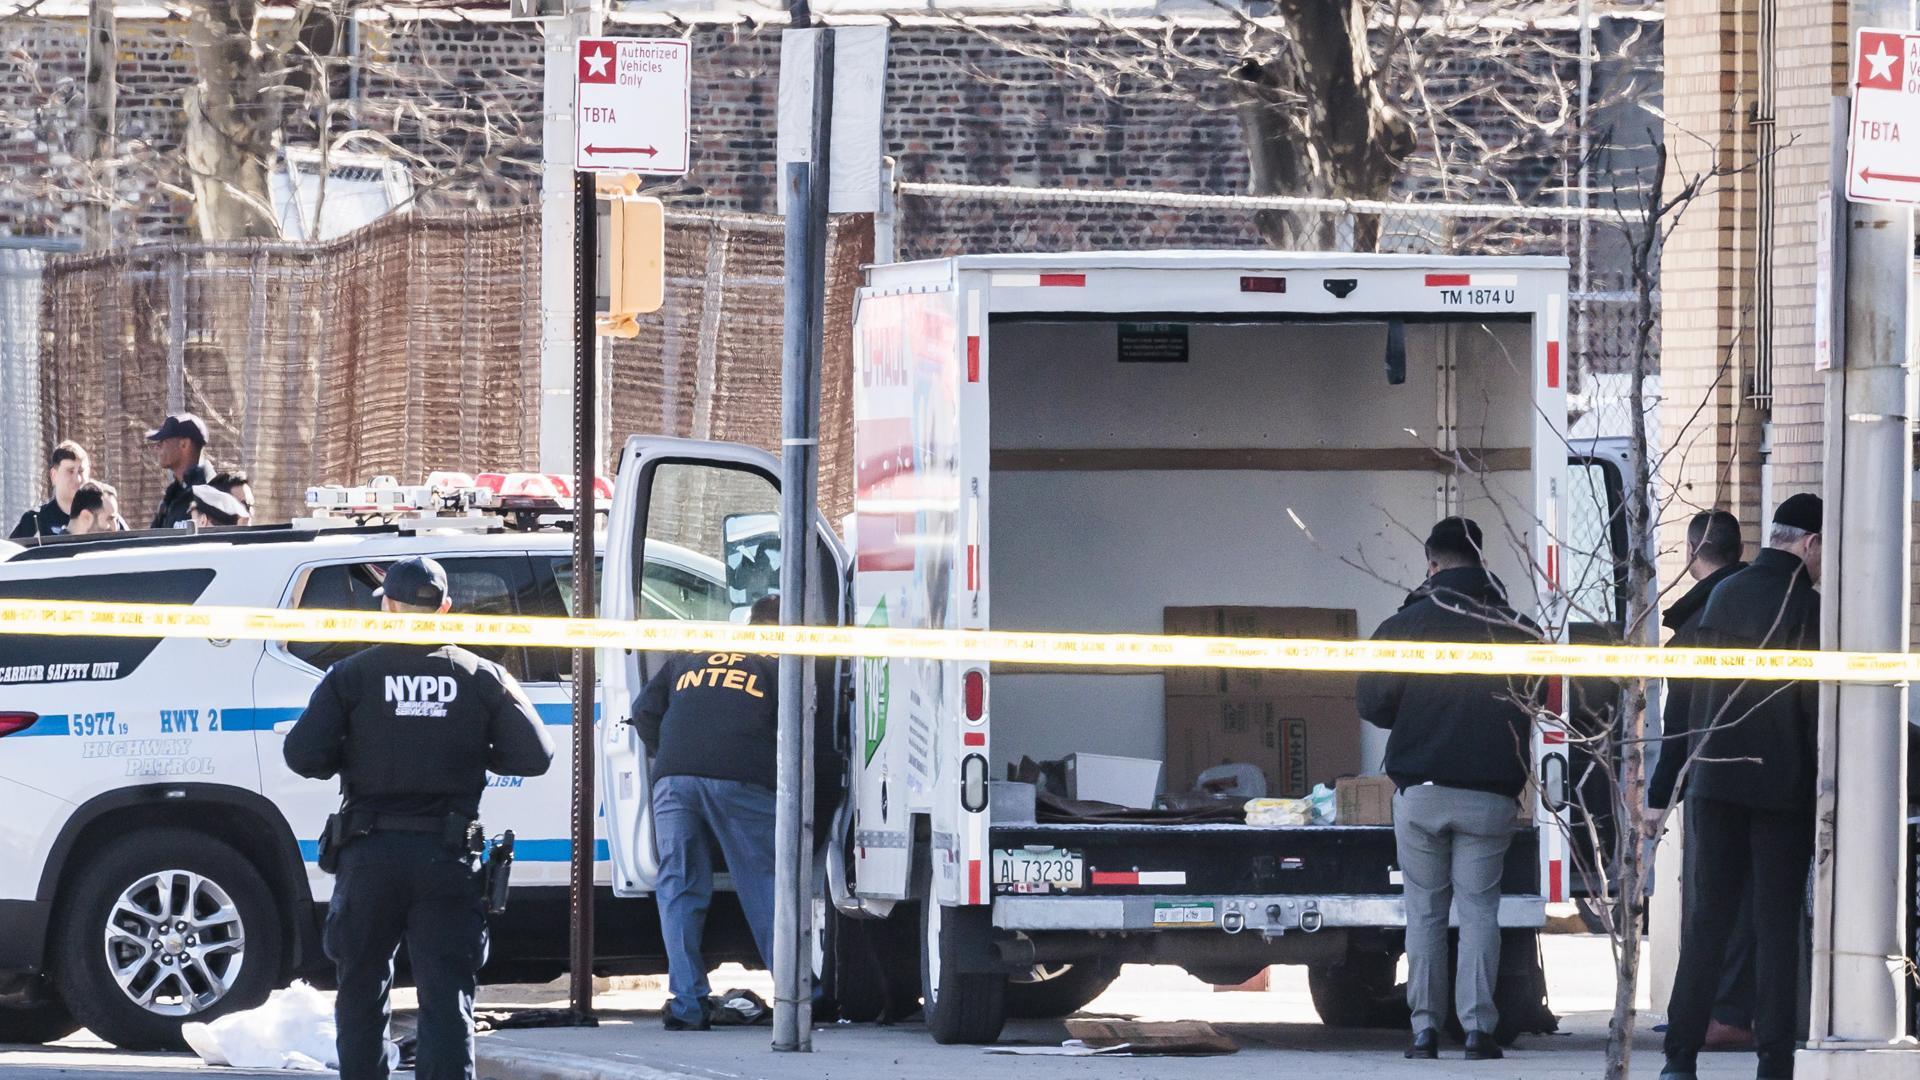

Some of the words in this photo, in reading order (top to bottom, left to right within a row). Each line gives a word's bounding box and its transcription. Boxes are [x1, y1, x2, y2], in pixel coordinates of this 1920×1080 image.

[621, 47, 678, 60] Authorized
[621, 60, 663, 73] Vehicles
[620, 73, 643, 88] Only
[584, 107, 617, 123] TBTA
[1860, 120, 1900, 142] TBTA
[1440, 290, 1462, 304] TM
[1467, 289, 1500, 305] 1874
[1505, 289, 1515, 304] U
[707, 653, 746, 666] OF
[0, 665, 45, 682] CARRIER
[46, 663, 90, 681] SAFETY
[91, 662, 120, 679] UNIT
[385, 675, 458, 702] NYPD
[675, 668, 764, 698] INTEL
[73, 711, 115, 736] 5977
[118, 723, 129, 735] 19
[160, 709, 199, 733] HWY
[208, 709, 218, 732] 2
[82, 738, 193, 758] HIGHWAY
[125, 757, 215, 777] PATROL
